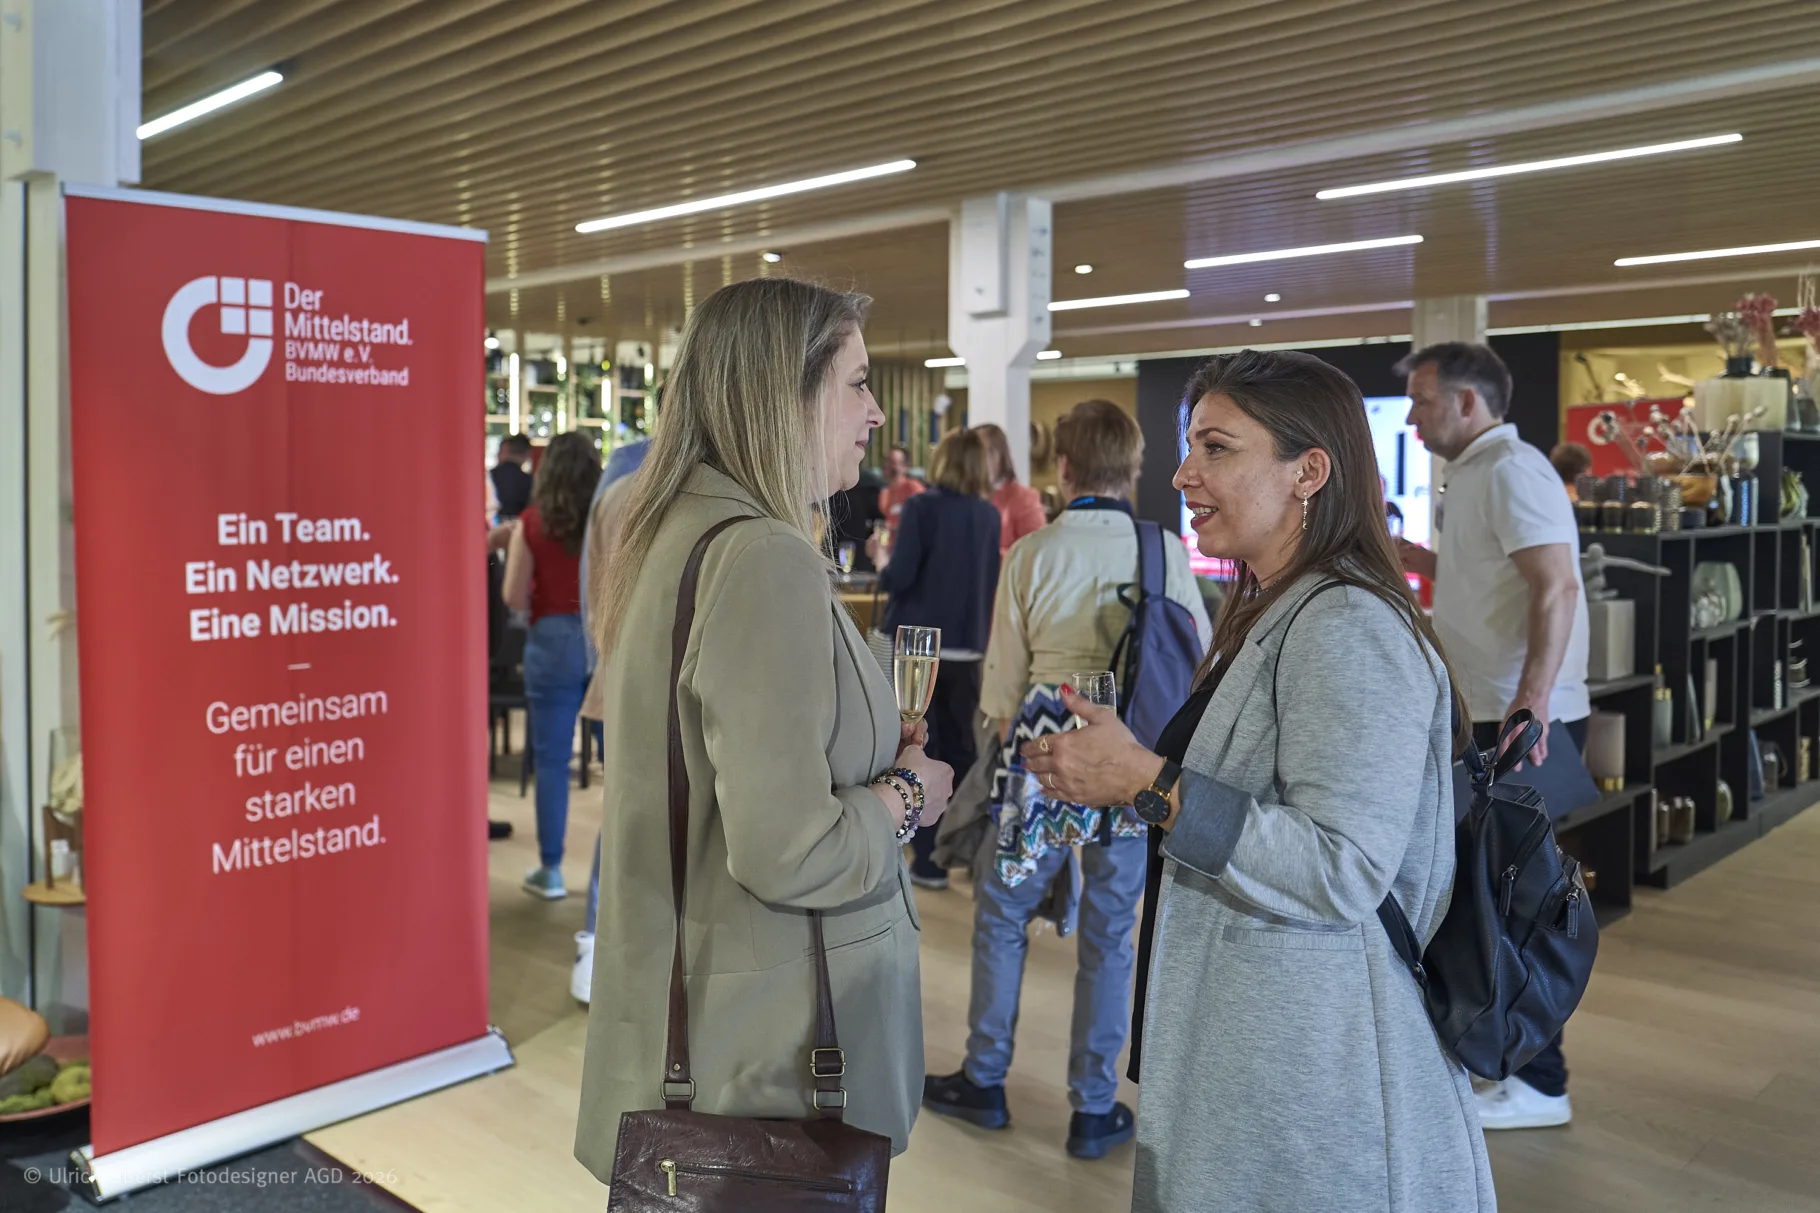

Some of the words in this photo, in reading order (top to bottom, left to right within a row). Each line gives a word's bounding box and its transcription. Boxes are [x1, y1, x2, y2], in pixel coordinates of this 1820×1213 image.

[283, 282, 323, 311] Der
[283, 312, 413, 346] Mittelstand.
[284, 342, 340, 363] BVMW
[284, 363, 409, 387] Bundesverband
[217, 513, 268, 546] Ein
[275, 513, 370, 543] Team.
[185, 561, 236, 594] Ein
[246, 554, 399, 590] Netzwerk.
[190, 606, 261, 641] Eine
[269, 600, 397, 637] Mission.
[206, 690, 388, 735] Gemeinsam
[234, 744, 278, 778] für
[285, 737, 364, 770] einen
[245, 782, 356, 822] starken
[212, 815, 387, 874] Mittelstand.
